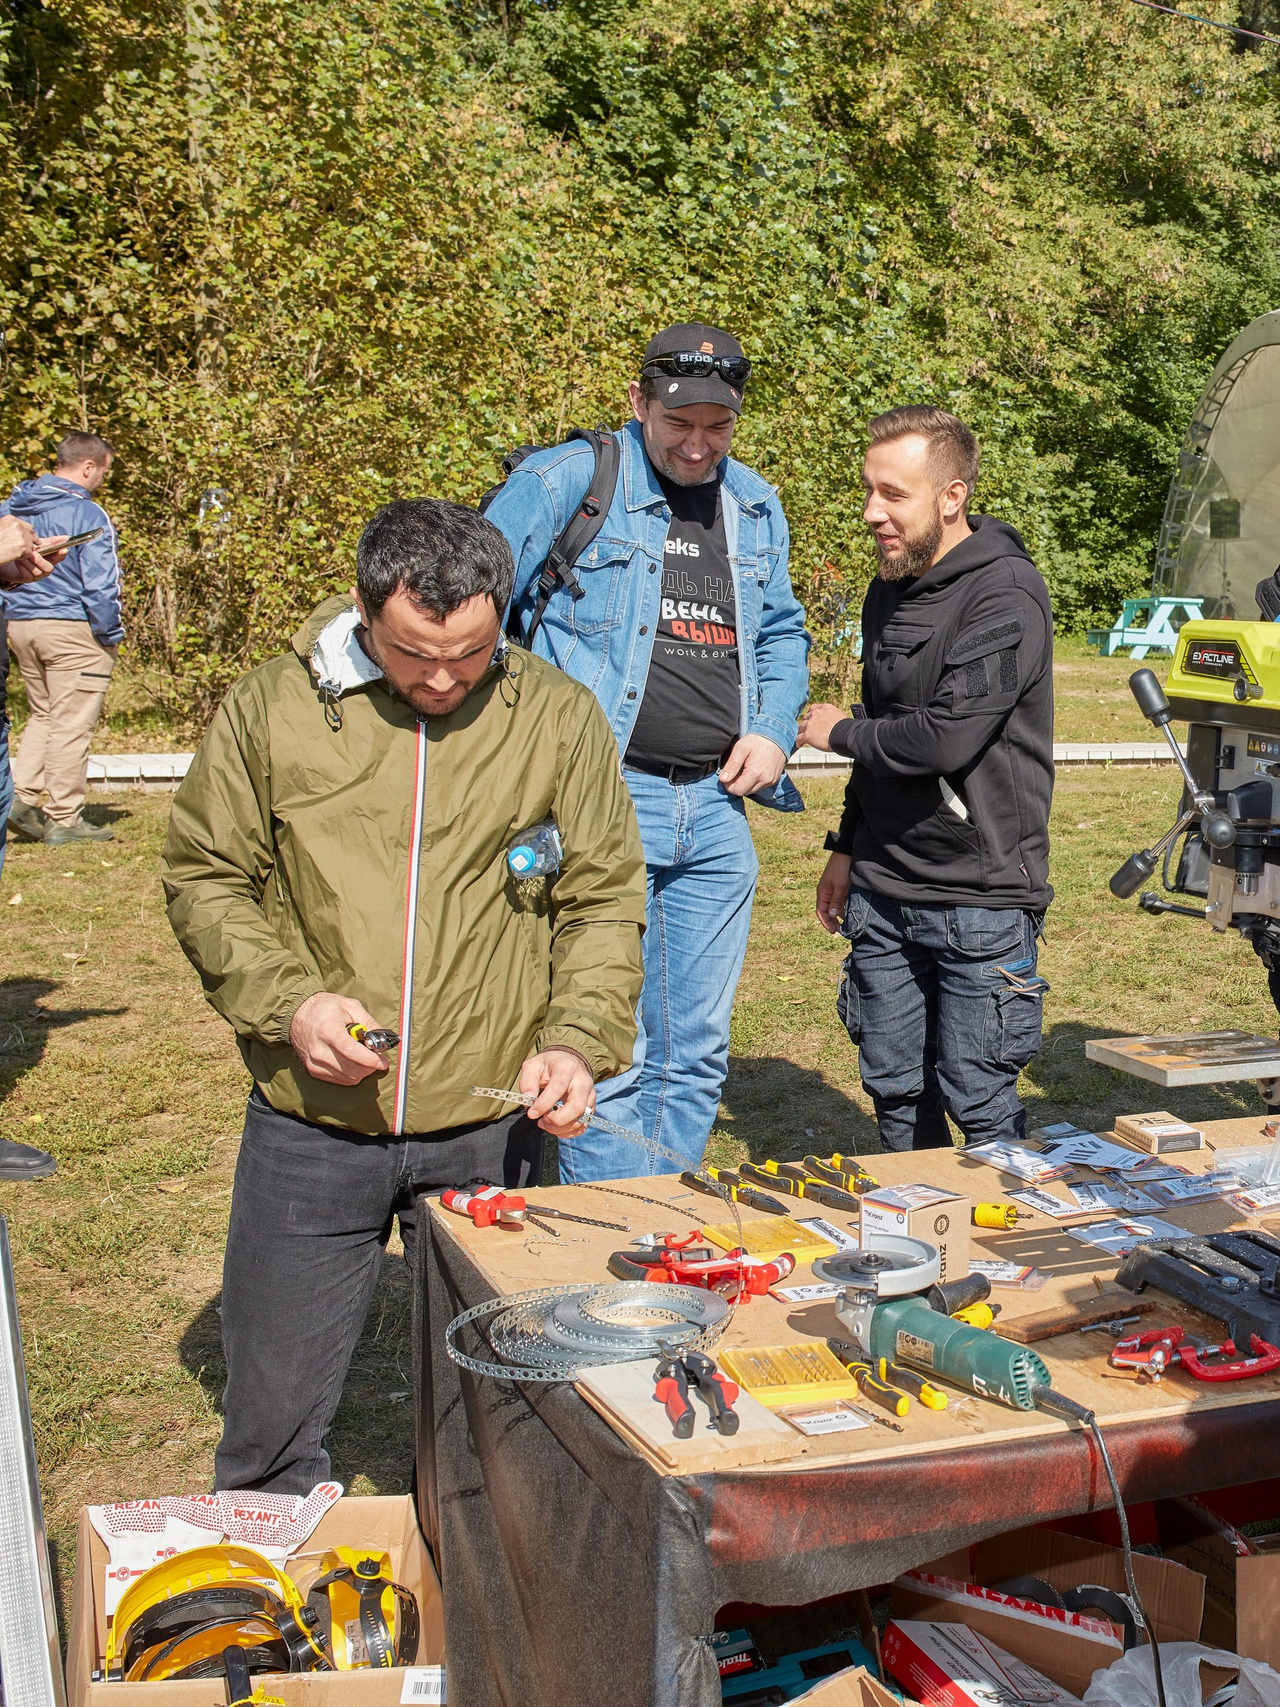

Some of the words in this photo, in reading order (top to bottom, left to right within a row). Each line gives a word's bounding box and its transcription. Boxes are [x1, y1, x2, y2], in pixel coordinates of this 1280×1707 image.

[660, 568, 698, 598] ДЬ
[664, 647, 698, 658] work
[1192, 650, 1235, 665] EXACTLINE
[233, 1508, 281, 1525] REXANT
